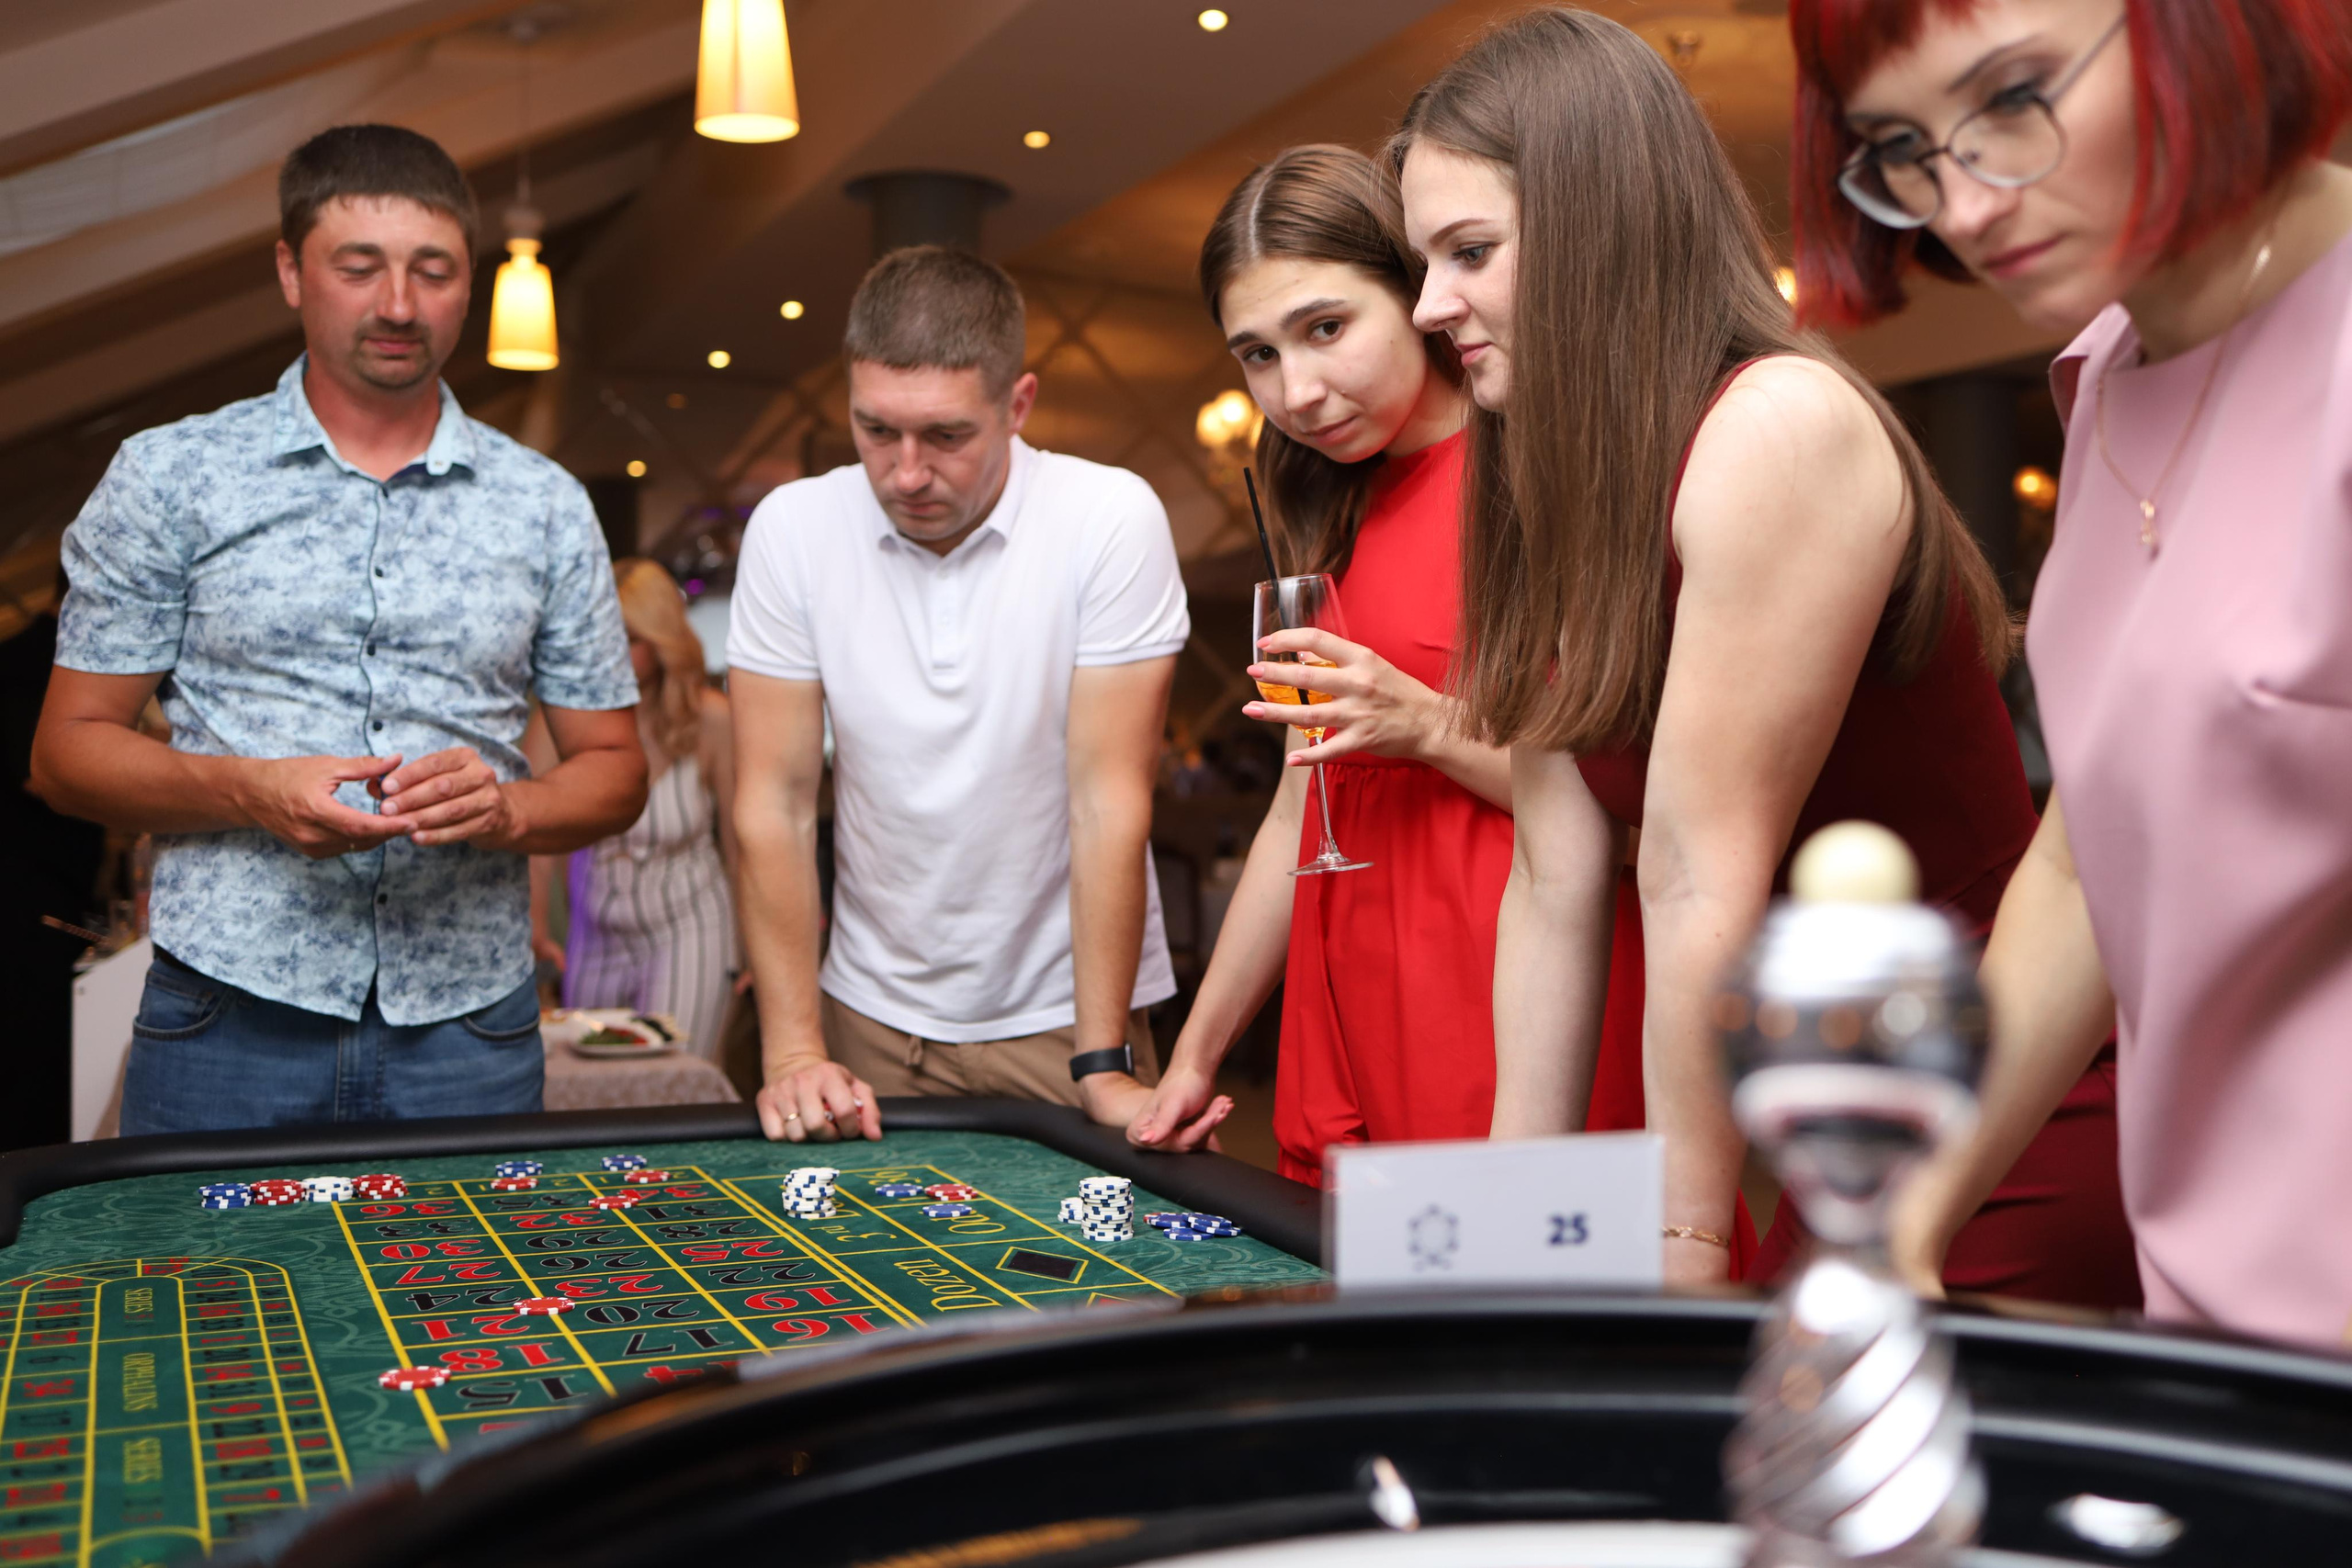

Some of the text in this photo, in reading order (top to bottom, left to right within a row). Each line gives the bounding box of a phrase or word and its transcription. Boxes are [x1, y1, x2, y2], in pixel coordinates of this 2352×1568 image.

[360, 1201, 457, 1219] 36
[510, 1211, 606, 1229] 32
[634, 1202, 728, 1221] 31
[376, 1219, 473, 1237] 33
[656, 1221, 756, 1239] 28
[919, 1210, 1006, 1235] Od
[1547, 1212, 1589, 1247] 25
[380, 1239, 484, 1259] 30
[526, 1229, 625, 1249] 29
[681, 1240, 784, 1262] 25
[396, 1261, 501, 1284] 27
[540, 1251, 648, 1274] 26
[708, 1263, 816, 1285] 22
[555, 1274, 663, 1298] 23
[894, 1258, 1003, 1312] Dozen
[125, 1287, 153, 1314] SERIES
[406, 1286, 520, 1311] 24
[744, 1286, 852, 1311] 19
[584, 1299, 700, 1325] 20
[412, 1314, 530, 1340] 21
[772, 1313, 889, 1342] 16
[623, 1327, 734, 1356] 17
[439, 1342, 565, 1372] 18
[456, 1374, 589, 1410] 15
